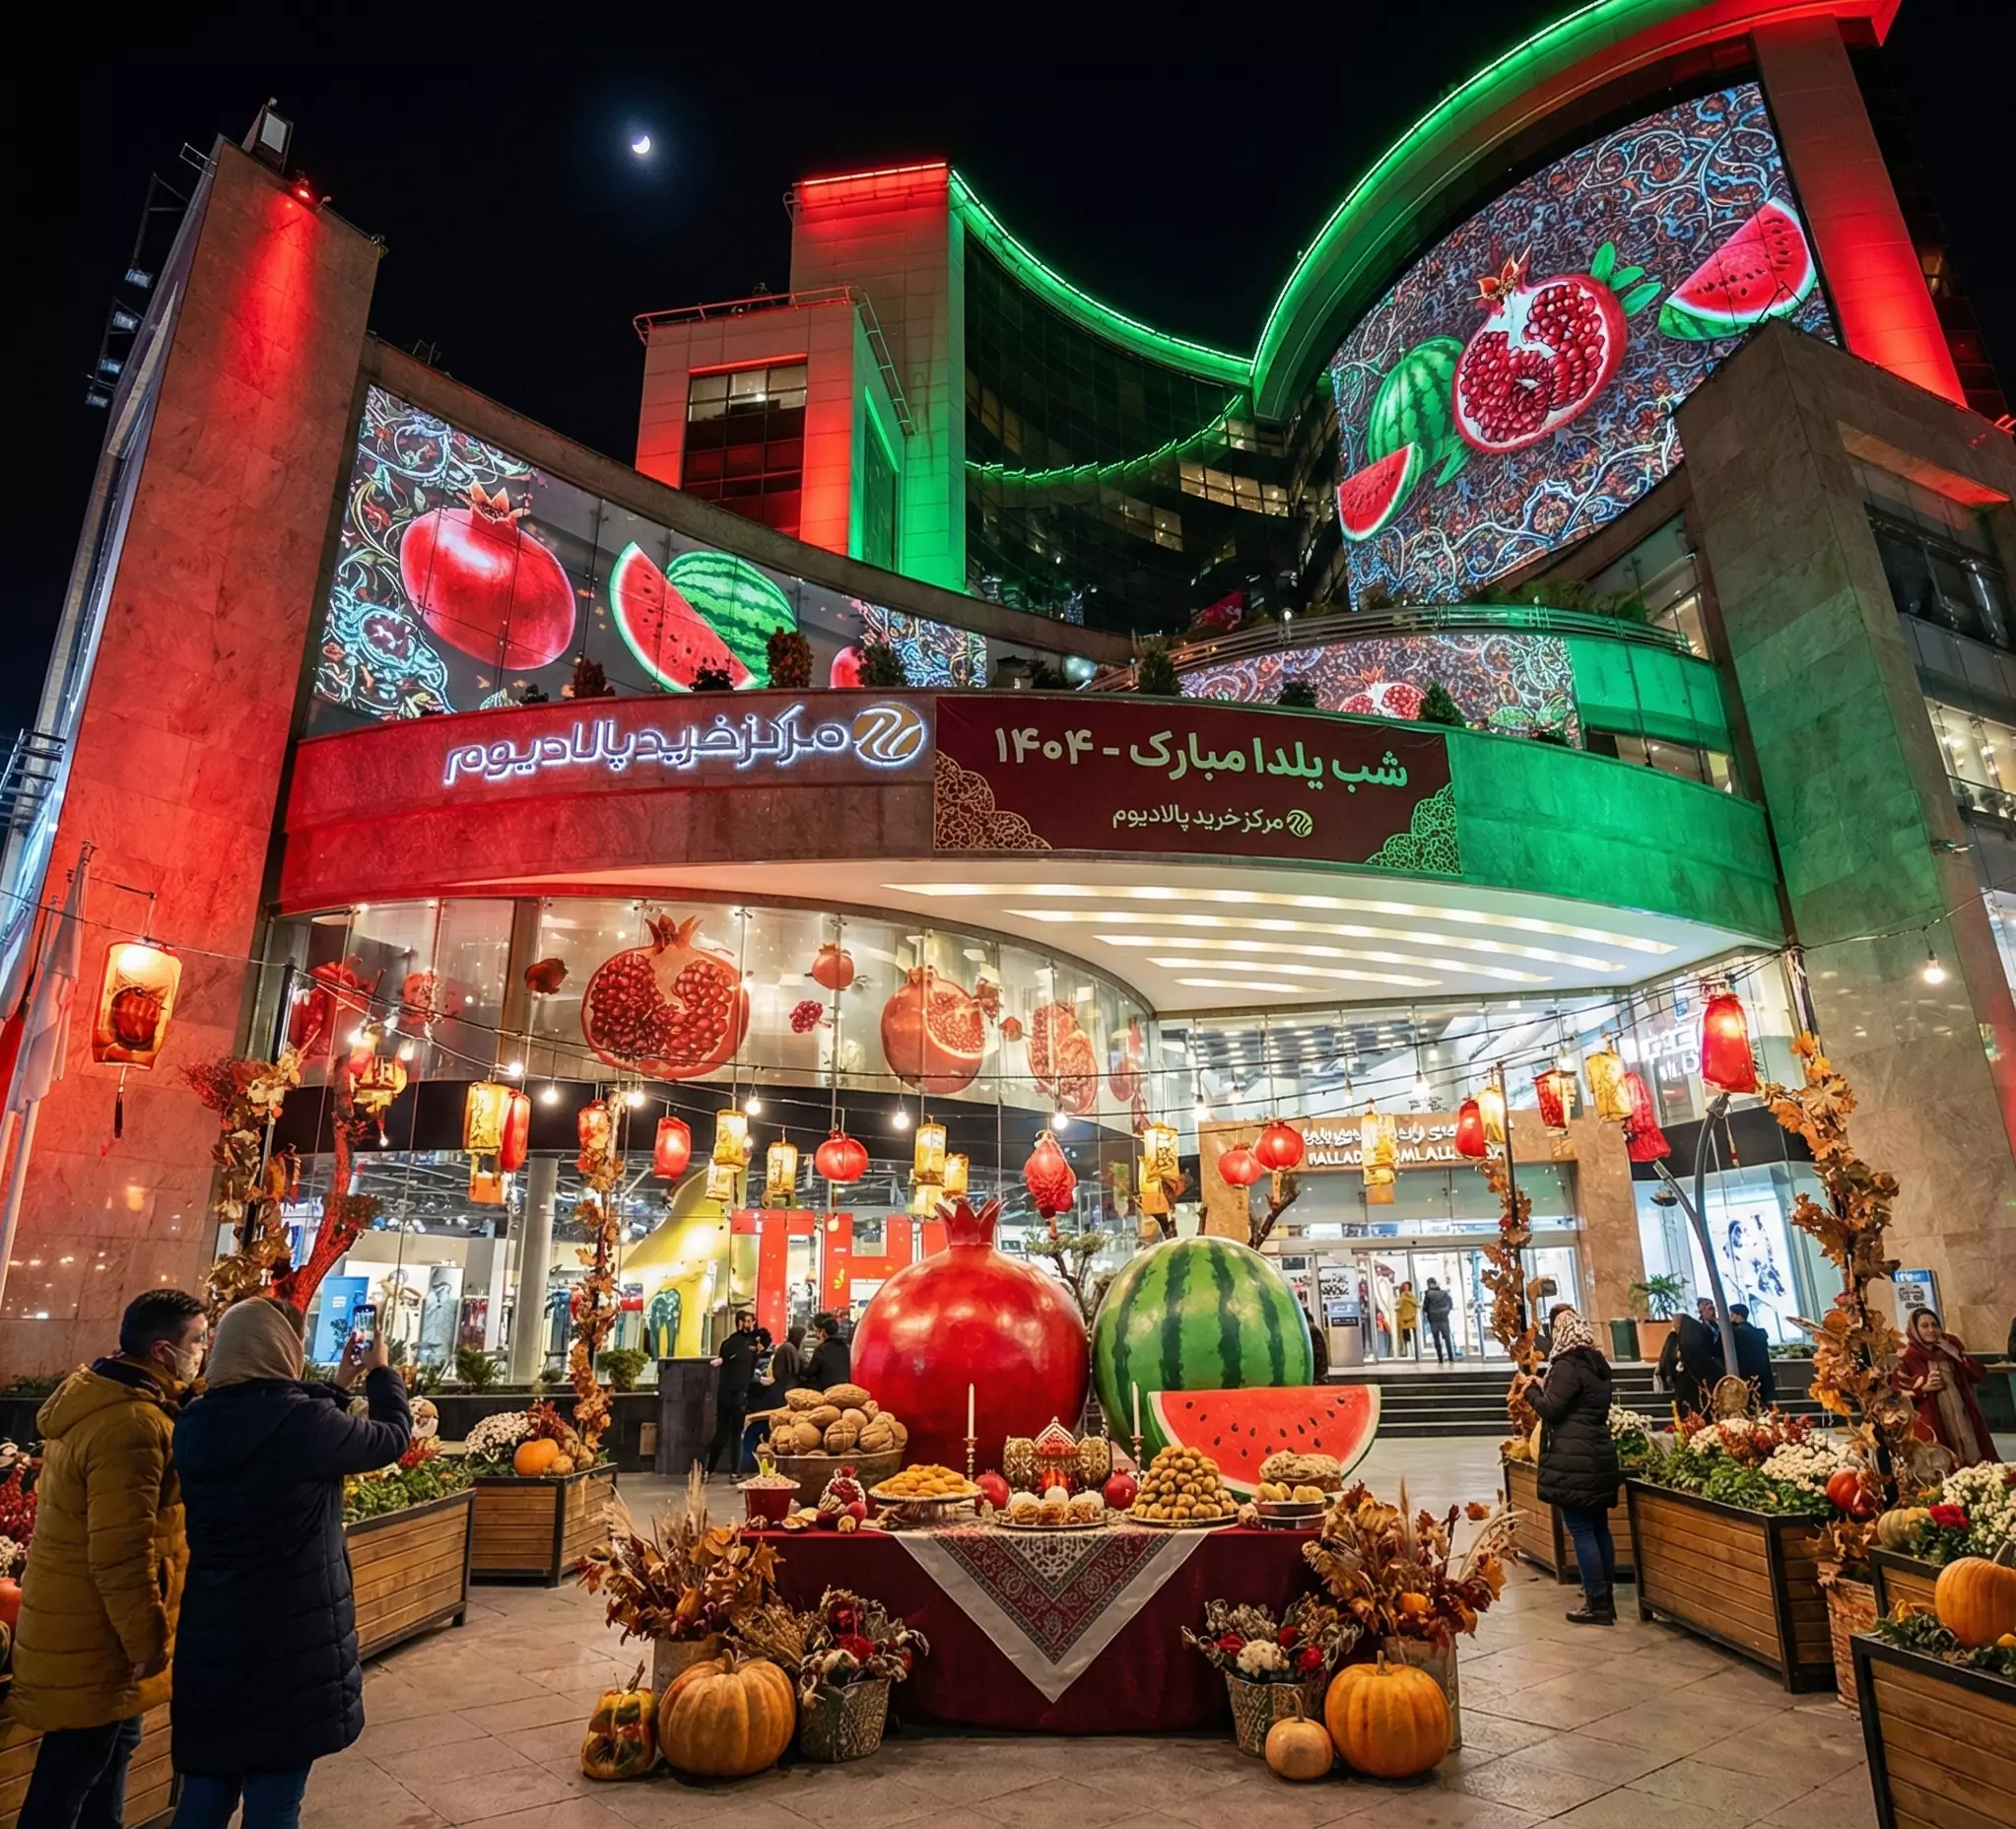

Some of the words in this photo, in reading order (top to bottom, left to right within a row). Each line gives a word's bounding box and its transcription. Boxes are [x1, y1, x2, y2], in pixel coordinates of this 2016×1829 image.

[442, 719, 636, 785] پالادیوم
[635, 714, 740, 771] خرید
[734, 702, 848, 769] مرکز
[994, 727, 1094, 765] ۱۴۰۴
[1129, 730, 1246, 781] مبارک
[1252, 737, 1324, 790] یلدا
[1332, 751, 1408, 793] شب
[1112, 803, 1190, 832] پالادیوم
[1191, 807, 1242, 832] خرید
[1241, 808, 1285, 835] مرکز
